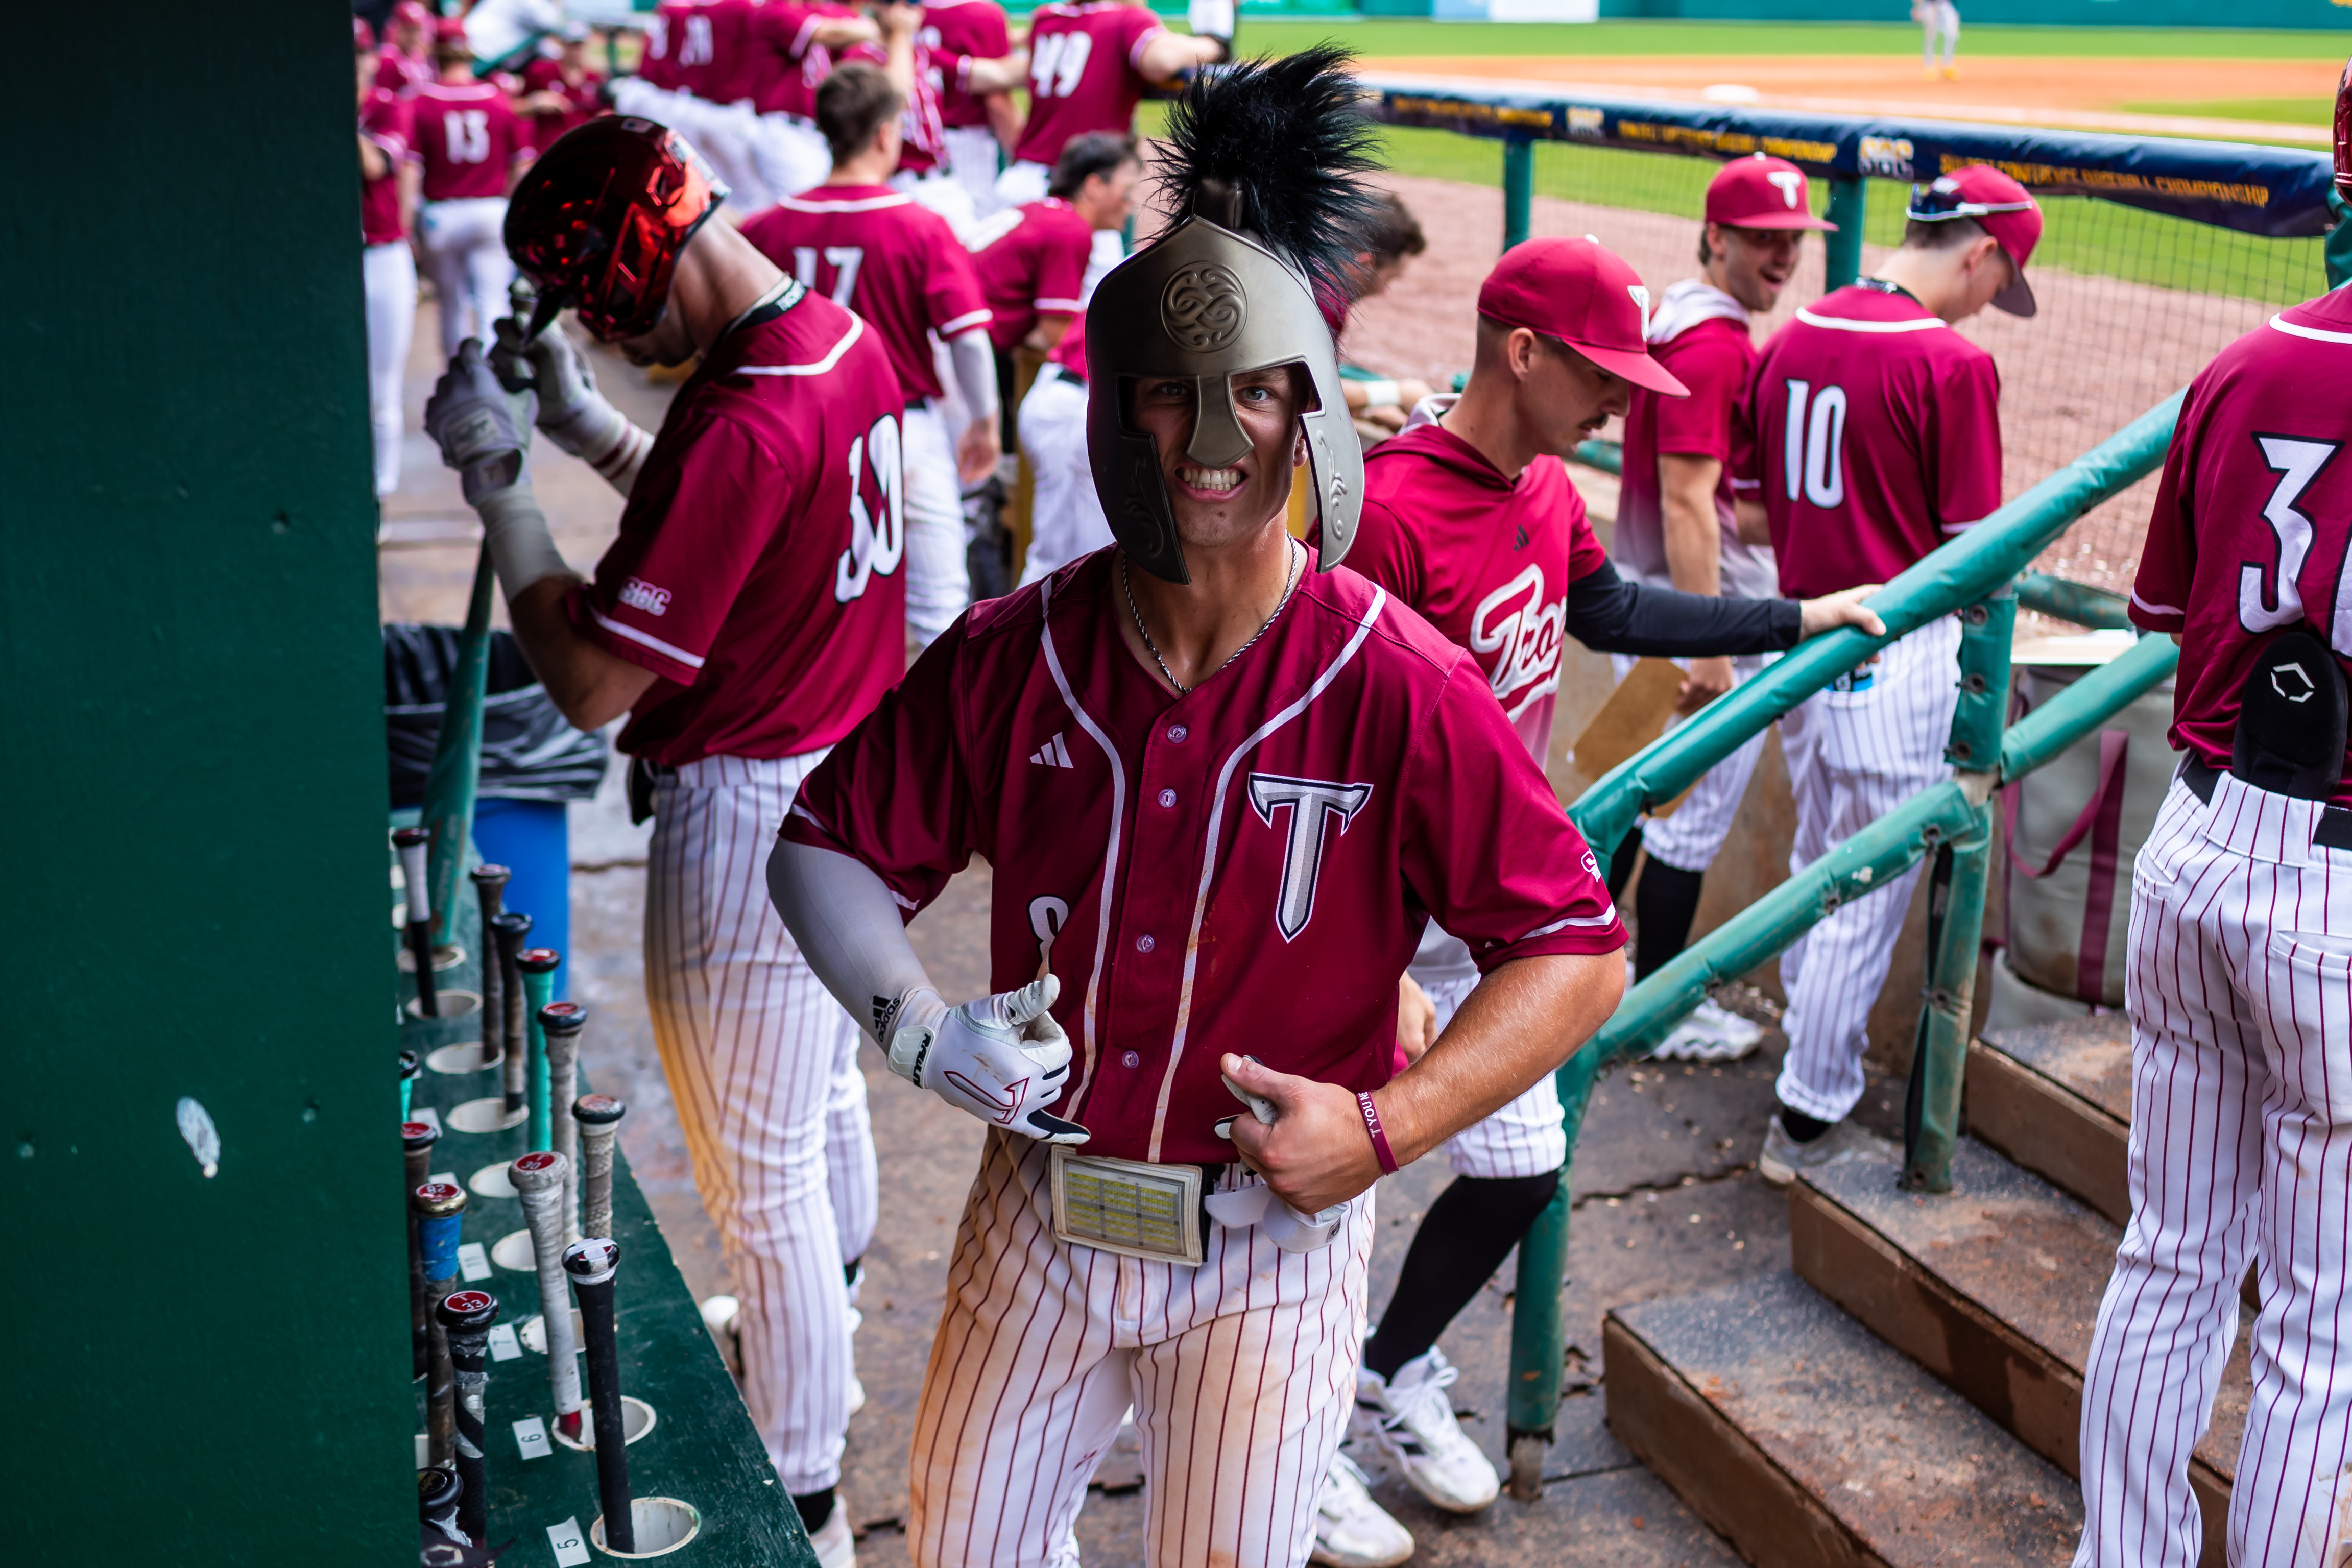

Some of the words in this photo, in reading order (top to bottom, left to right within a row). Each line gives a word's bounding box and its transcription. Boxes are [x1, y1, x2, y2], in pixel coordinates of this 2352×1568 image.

[792, 246, 864, 307] 17
[1783, 377, 1848, 510] 10
[2237, 431, 2352, 659] 3
[1247, 771, 1374, 944] T
[878, 997, 900, 1043] adidas
[1361, 1101, 1377, 1127] YOU
[521, 1161, 542, 1170] 30
[453, 1293, 468, 1301] T
[461, 1299, 485, 1311] 33
[521, 1433, 542, 1443] 6
[557, 1538, 579, 1550] 5
